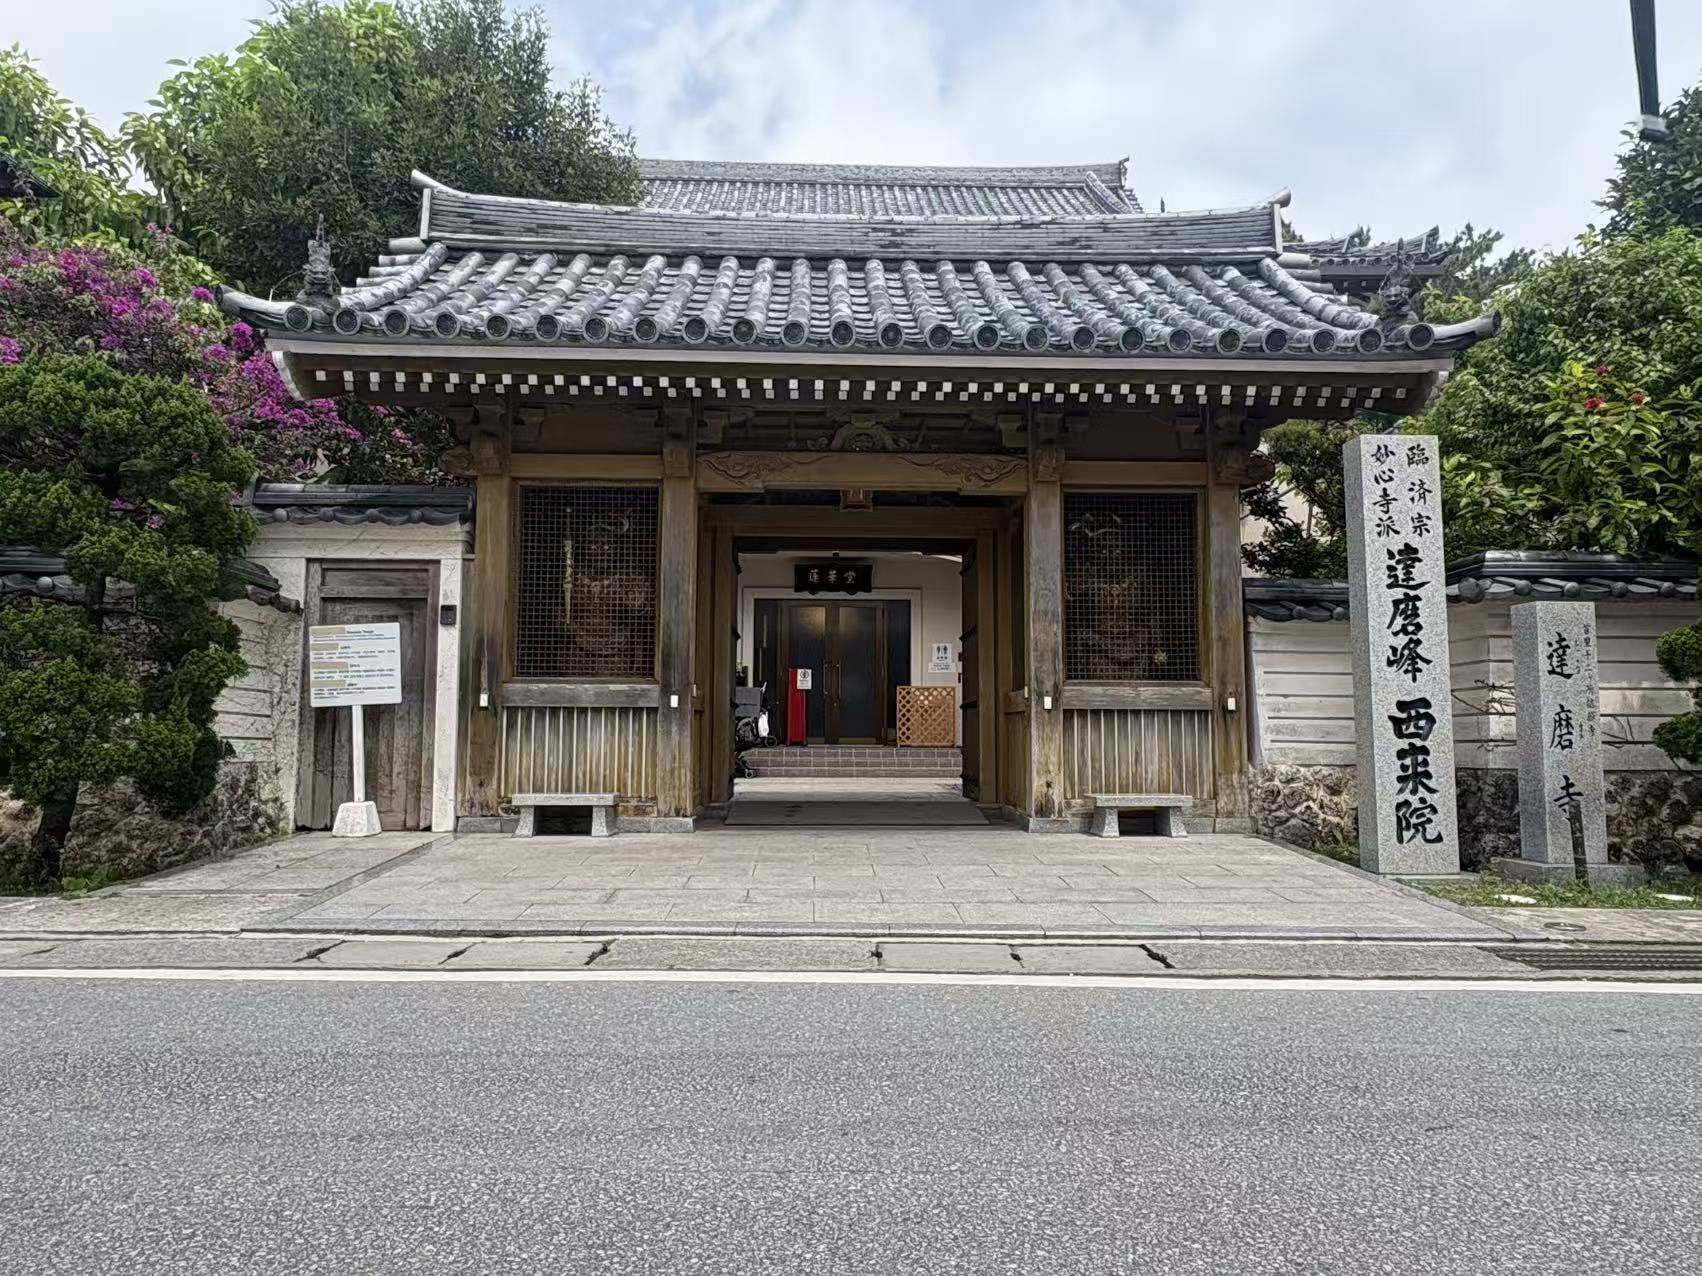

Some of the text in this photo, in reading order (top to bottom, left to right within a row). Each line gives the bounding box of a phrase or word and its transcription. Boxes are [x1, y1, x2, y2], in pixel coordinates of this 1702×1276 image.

[1370, 444, 1401, 538] 妙心寺派
[1406, 444, 1433, 537] 臨済宗
[1386, 542, 1444, 845] 達磨峰 西来院
[1546, 631, 1584, 823] 達磨寺
